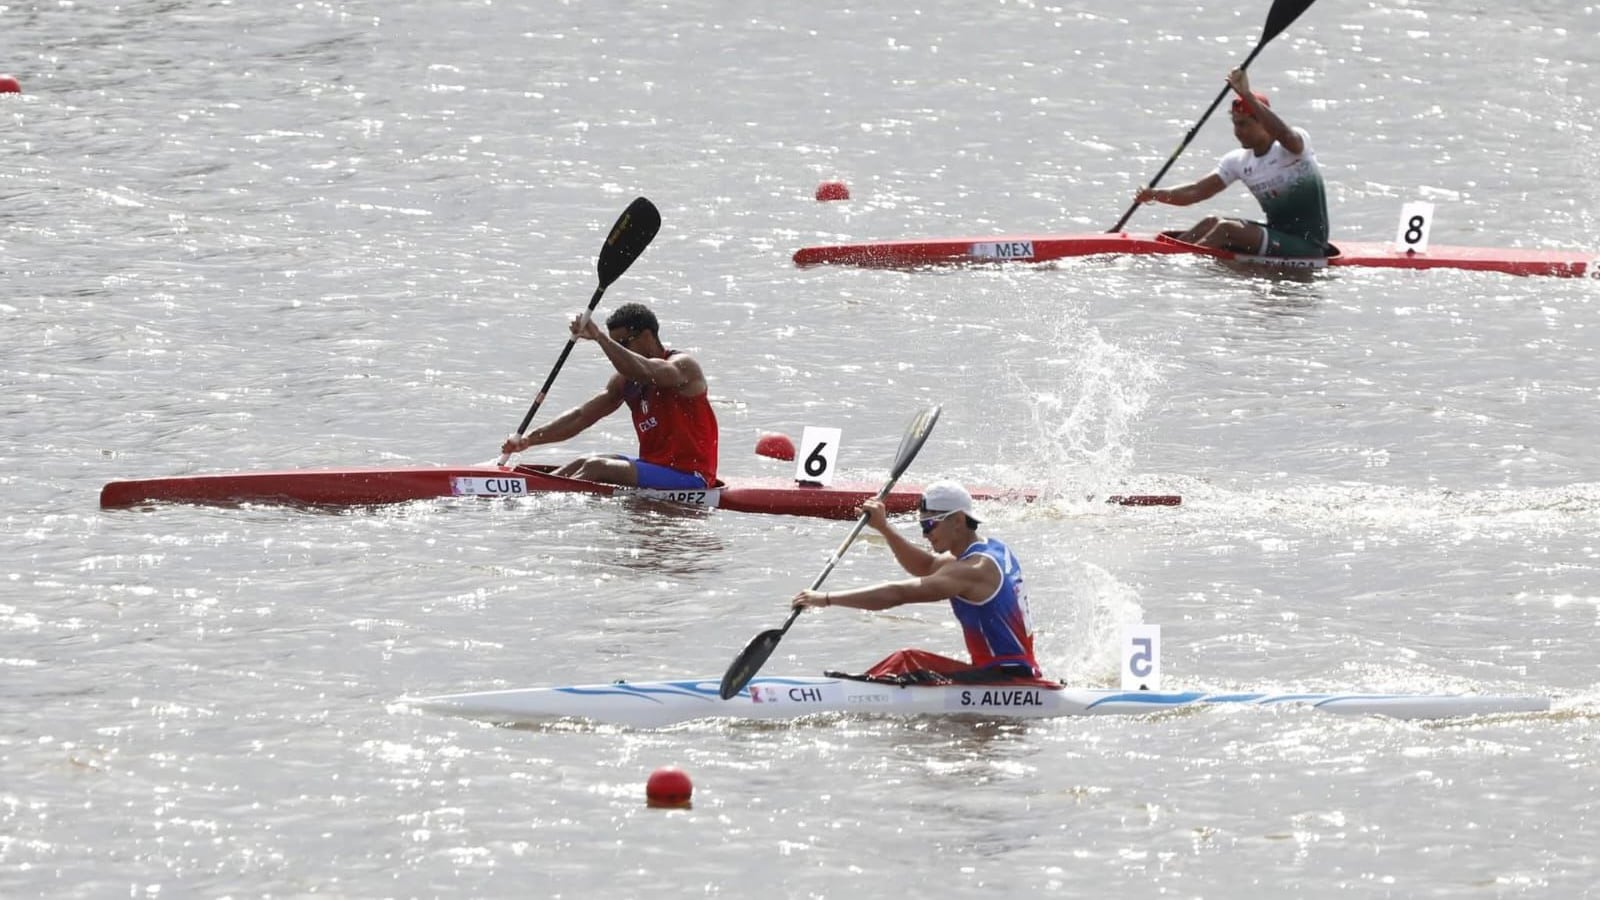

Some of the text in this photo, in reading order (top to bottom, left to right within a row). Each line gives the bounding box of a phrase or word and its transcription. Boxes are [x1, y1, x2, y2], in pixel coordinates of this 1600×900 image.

[1404, 214, 1425, 245] 8
[995, 242, 1032, 257] MEX
[804, 441, 828, 477] 6
[485, 479, 522, 494] CUB
[788, 687, 822, 703] CHI
[961, 690, 1043, 706] S. ALVEAL
